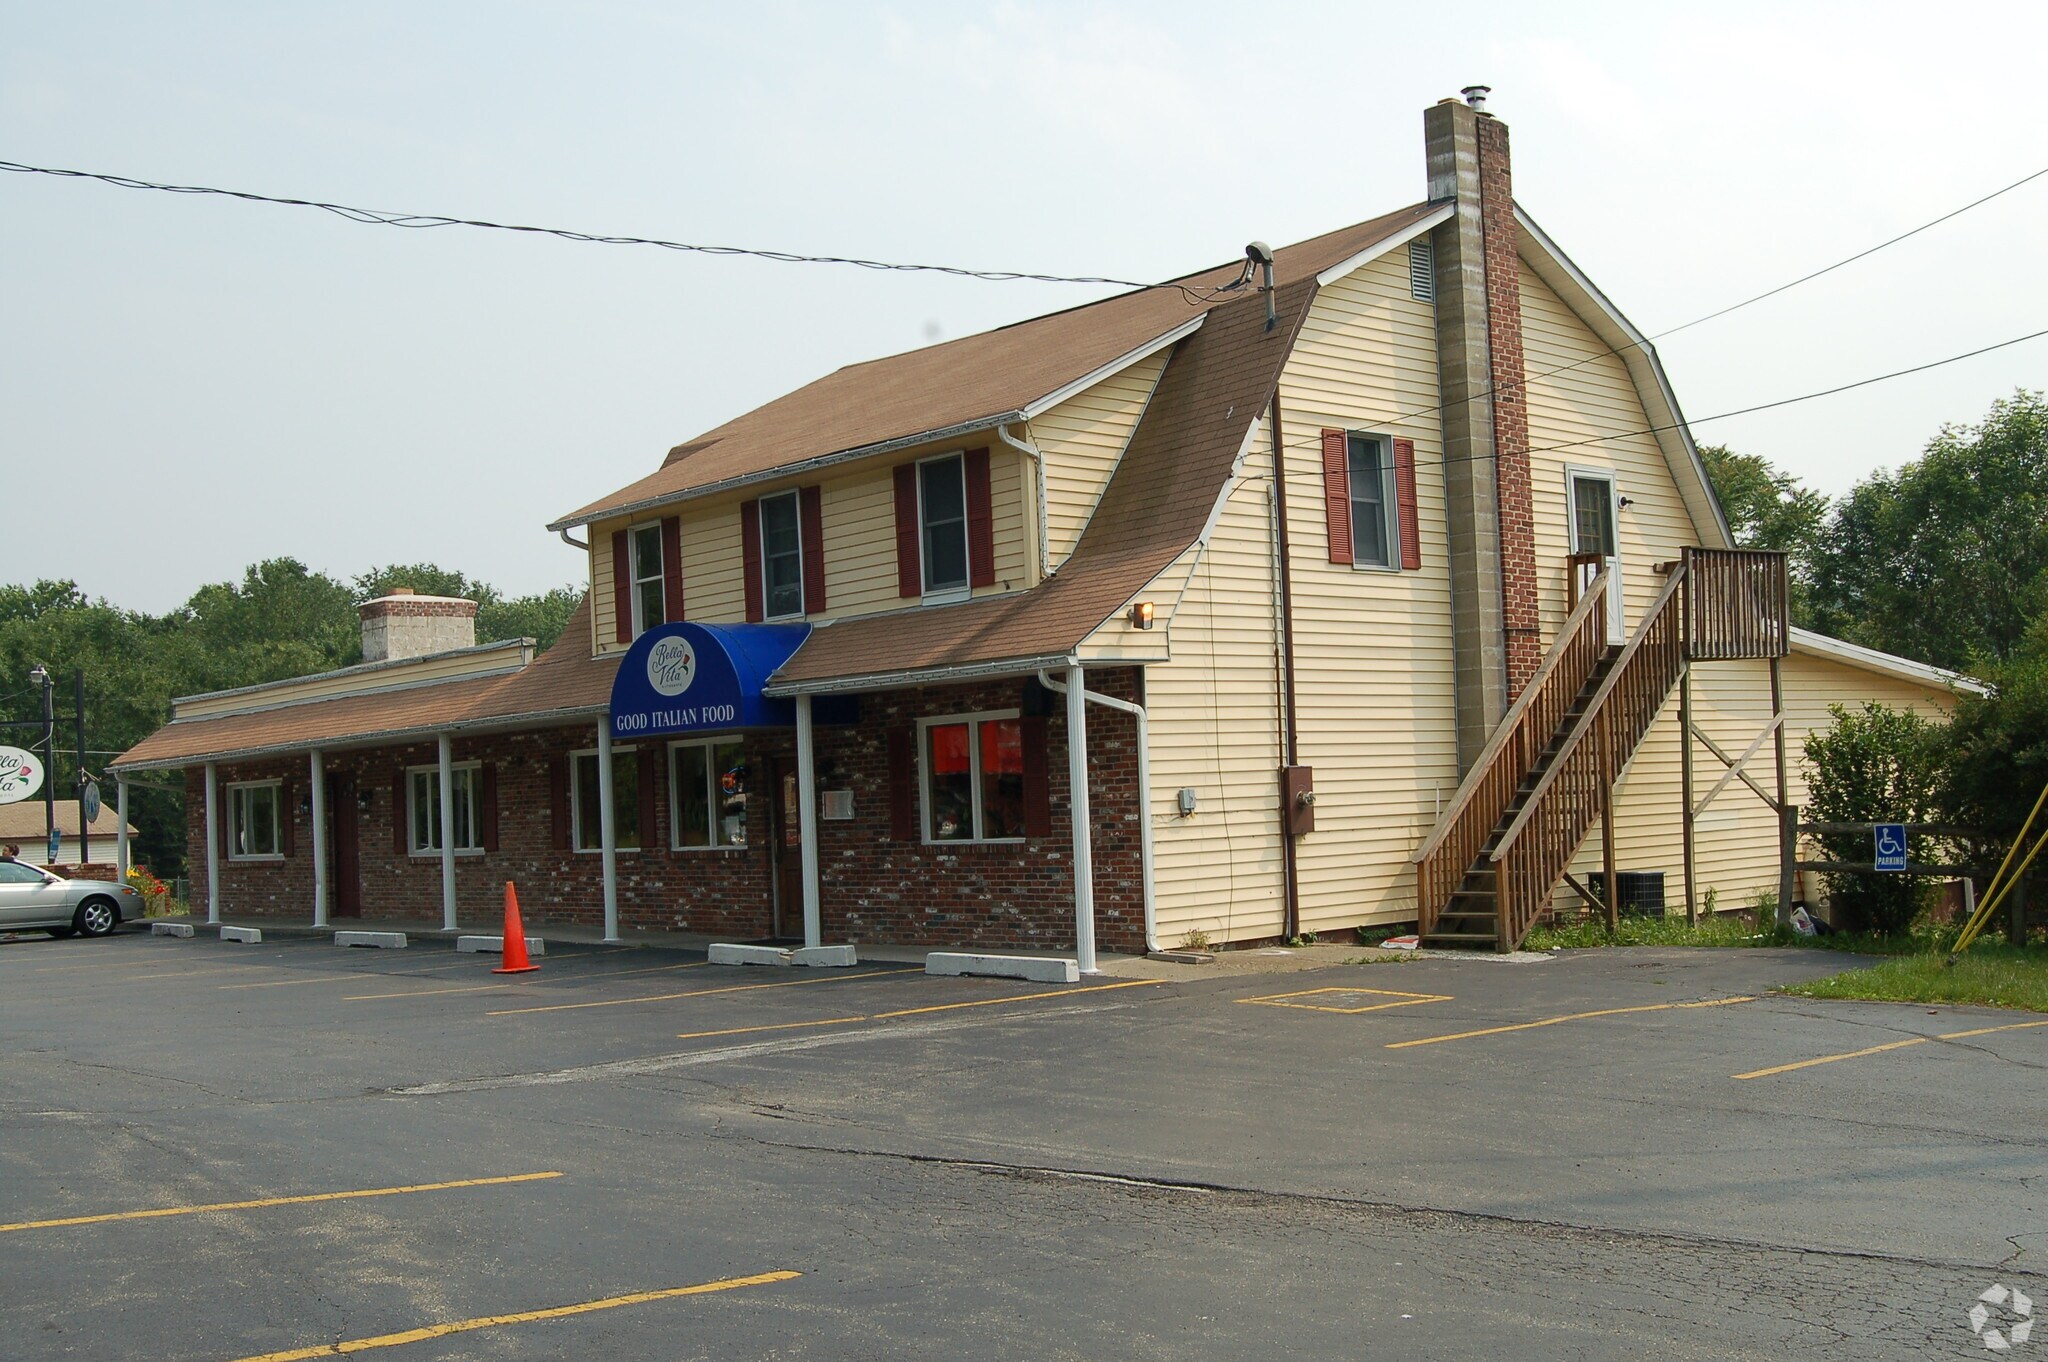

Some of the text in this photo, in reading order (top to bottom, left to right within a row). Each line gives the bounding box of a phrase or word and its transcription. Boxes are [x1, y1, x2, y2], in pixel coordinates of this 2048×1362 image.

[656, 643, 682, 666] Bella
[652, 661, 682, 685] Vita
[617, 704, 734, 731] GOOD ITALIAN FOOD
[1877, 856, 1904, 865] PARKING
